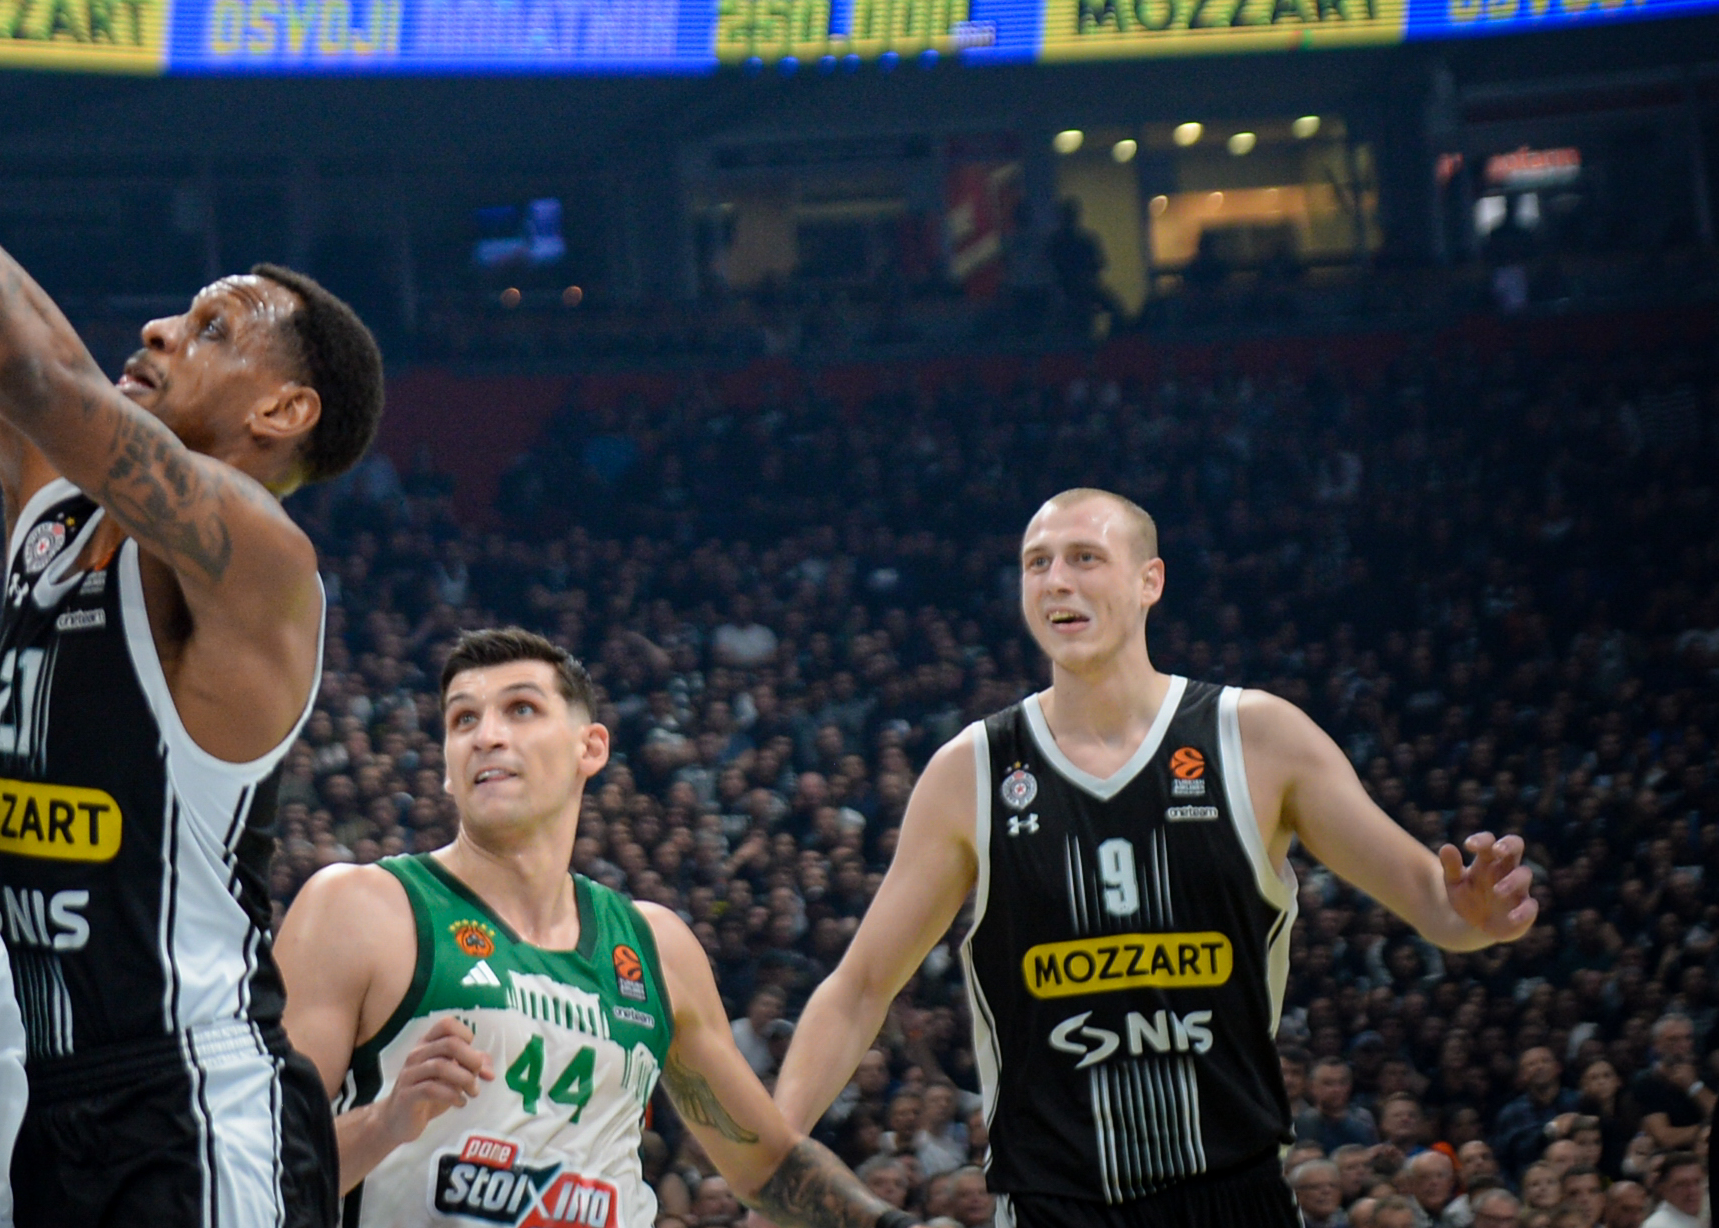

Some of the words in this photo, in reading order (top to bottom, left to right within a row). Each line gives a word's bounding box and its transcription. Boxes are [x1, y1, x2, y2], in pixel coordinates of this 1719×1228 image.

[1098, 837, 1139, 916] 9
[3, 885, 90, 951] NIS
[1035, 942, 1224, 988] MOZZART
[1126, 1010, 1213, 1055] NIS
[505, 1034, 596, 1124] 44
